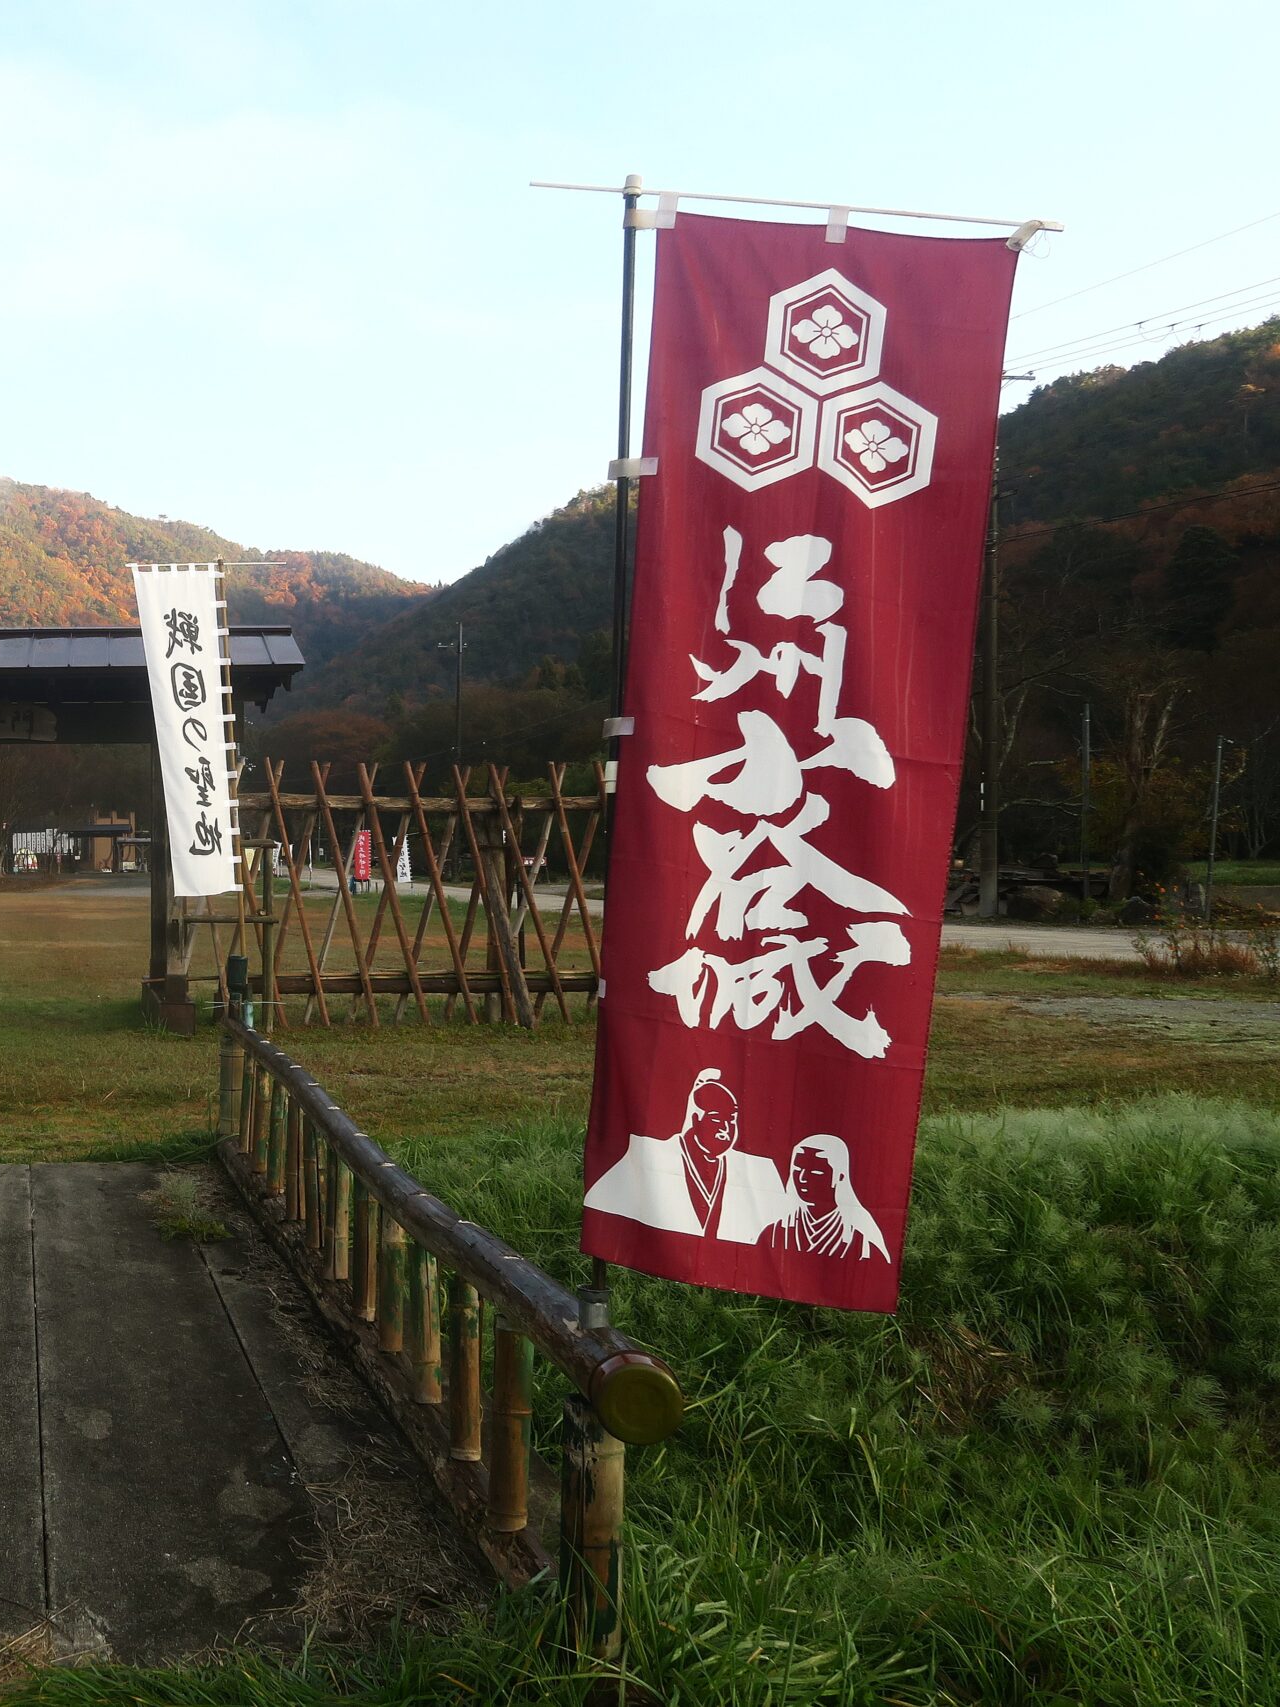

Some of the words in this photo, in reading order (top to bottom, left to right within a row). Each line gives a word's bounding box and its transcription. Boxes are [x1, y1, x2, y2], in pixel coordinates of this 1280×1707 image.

[646, 526, 914, 1059] 江州小谷城
